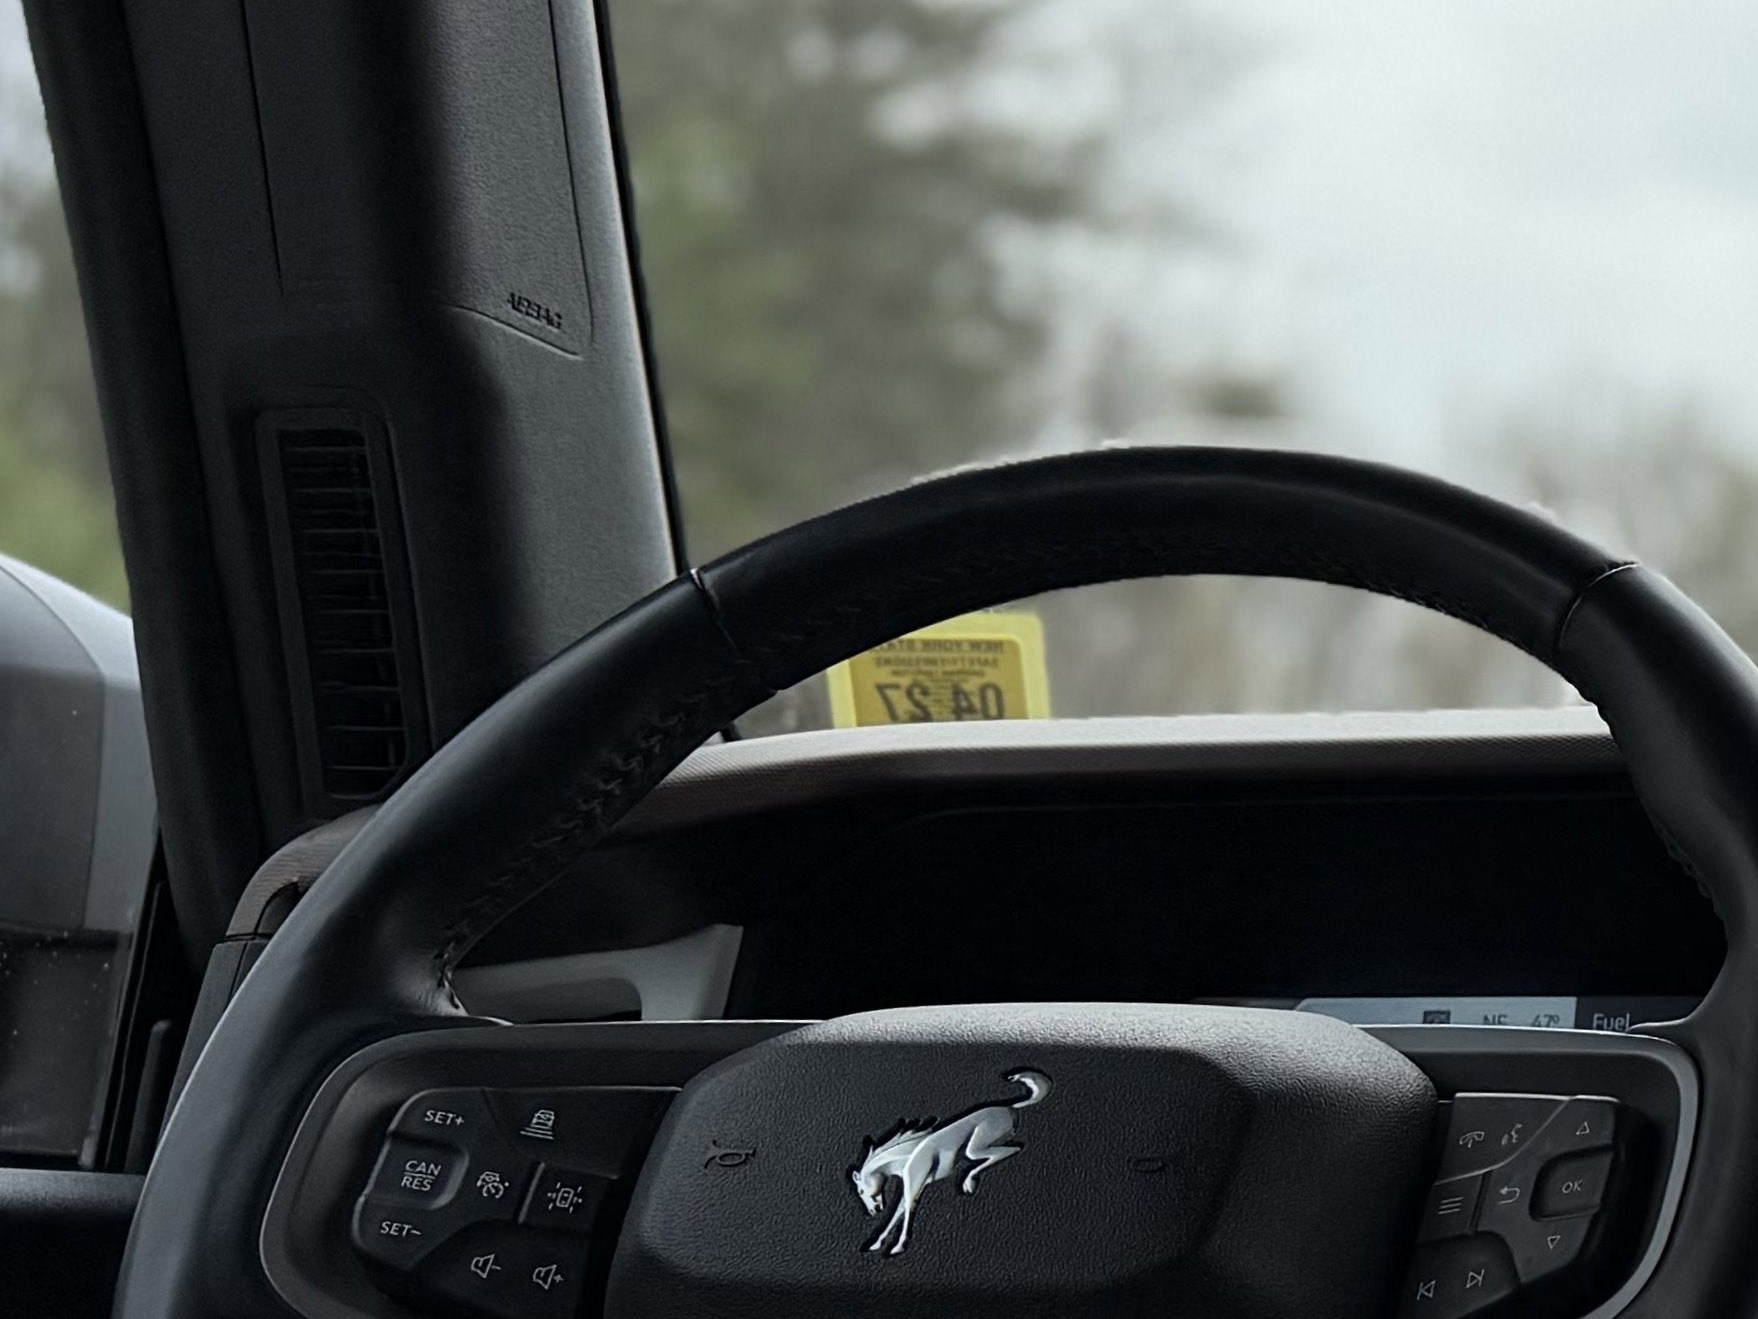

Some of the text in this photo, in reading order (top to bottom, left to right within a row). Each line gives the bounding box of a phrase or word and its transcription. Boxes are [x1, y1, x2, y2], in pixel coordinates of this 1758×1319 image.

[1592, 1012, 1631, 1032] Fuel
[404, 1159, 442, 1176] CAN
[400, 1176, 432, 1192] RES
[1561, 1179, 1584, 1194] OK
